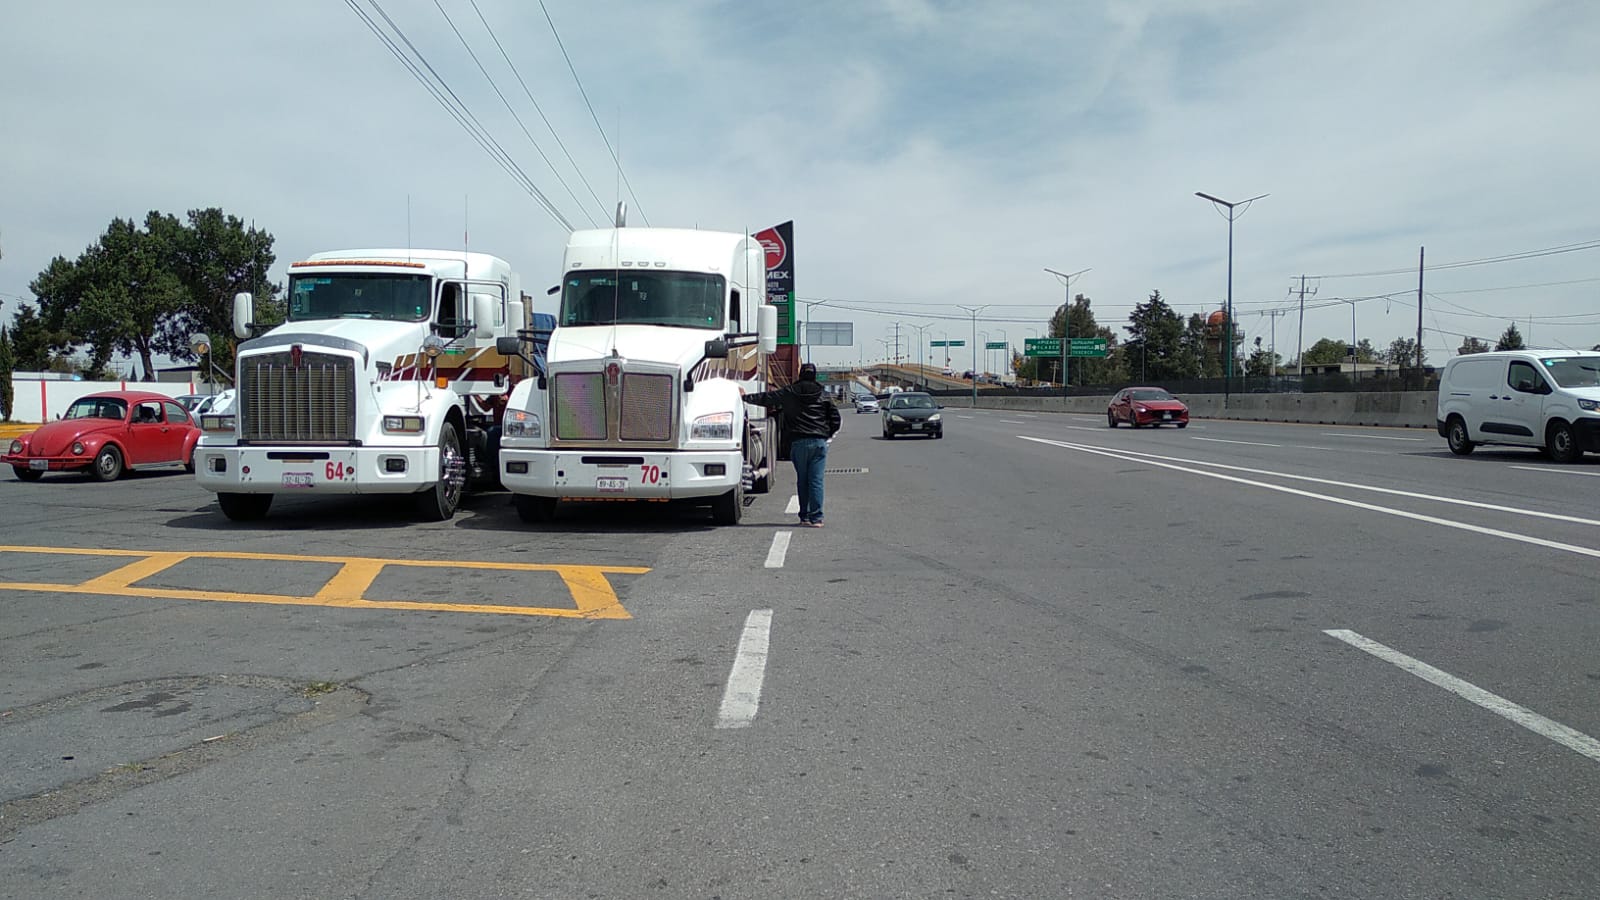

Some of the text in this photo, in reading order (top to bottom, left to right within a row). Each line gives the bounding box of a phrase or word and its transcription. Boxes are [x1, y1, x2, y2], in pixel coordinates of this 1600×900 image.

[767, 271, 789, 279] MEX
[325, 461, 344, 480] 64
[641, 465, 659, 484] 70
